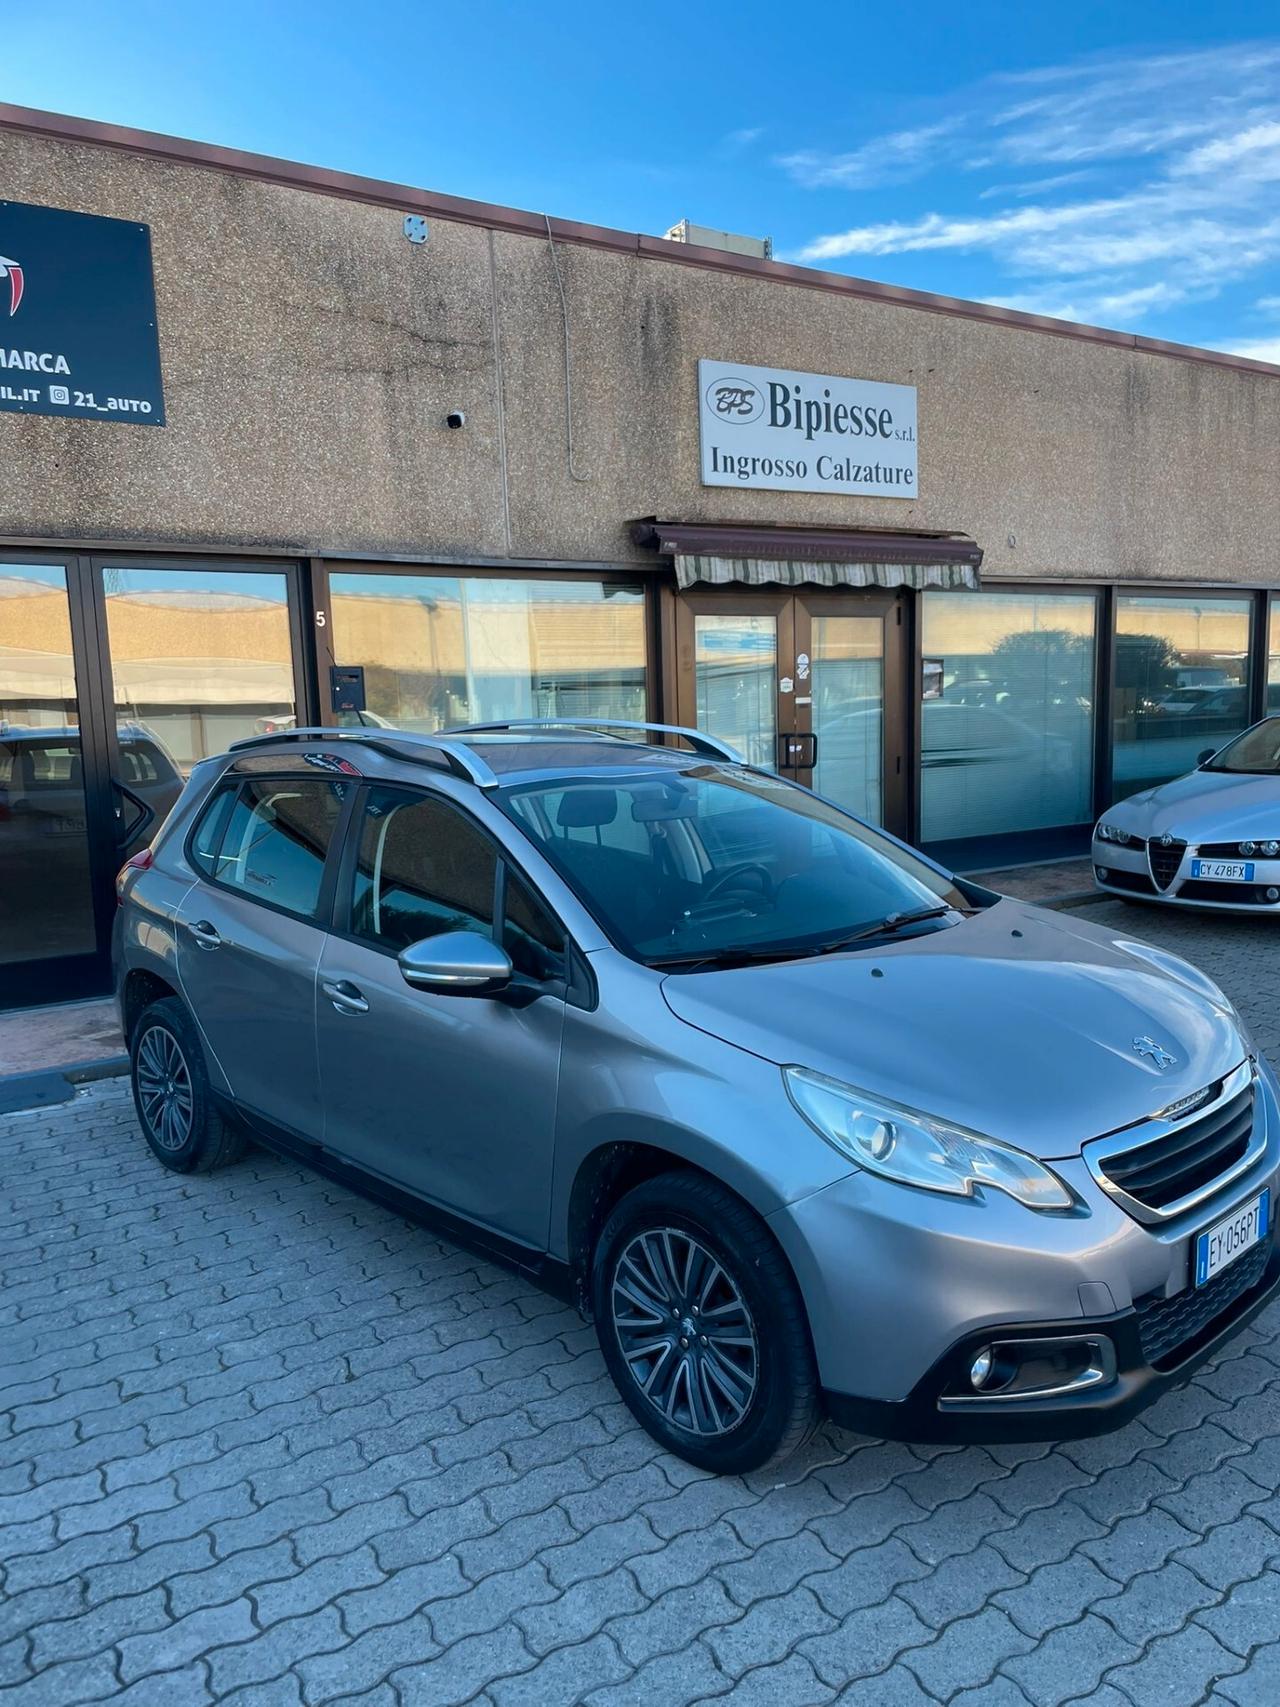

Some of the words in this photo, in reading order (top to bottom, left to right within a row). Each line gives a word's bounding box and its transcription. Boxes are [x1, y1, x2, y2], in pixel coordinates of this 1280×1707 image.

[767, 381, 893, 441] Bipiesse
[895, 426, 915, 442] s.r.l.
[711, 446, 808, 480] Ingrosso
[816, 455, 914, 485] Calzature
[315, 611, 326, 627] 5
